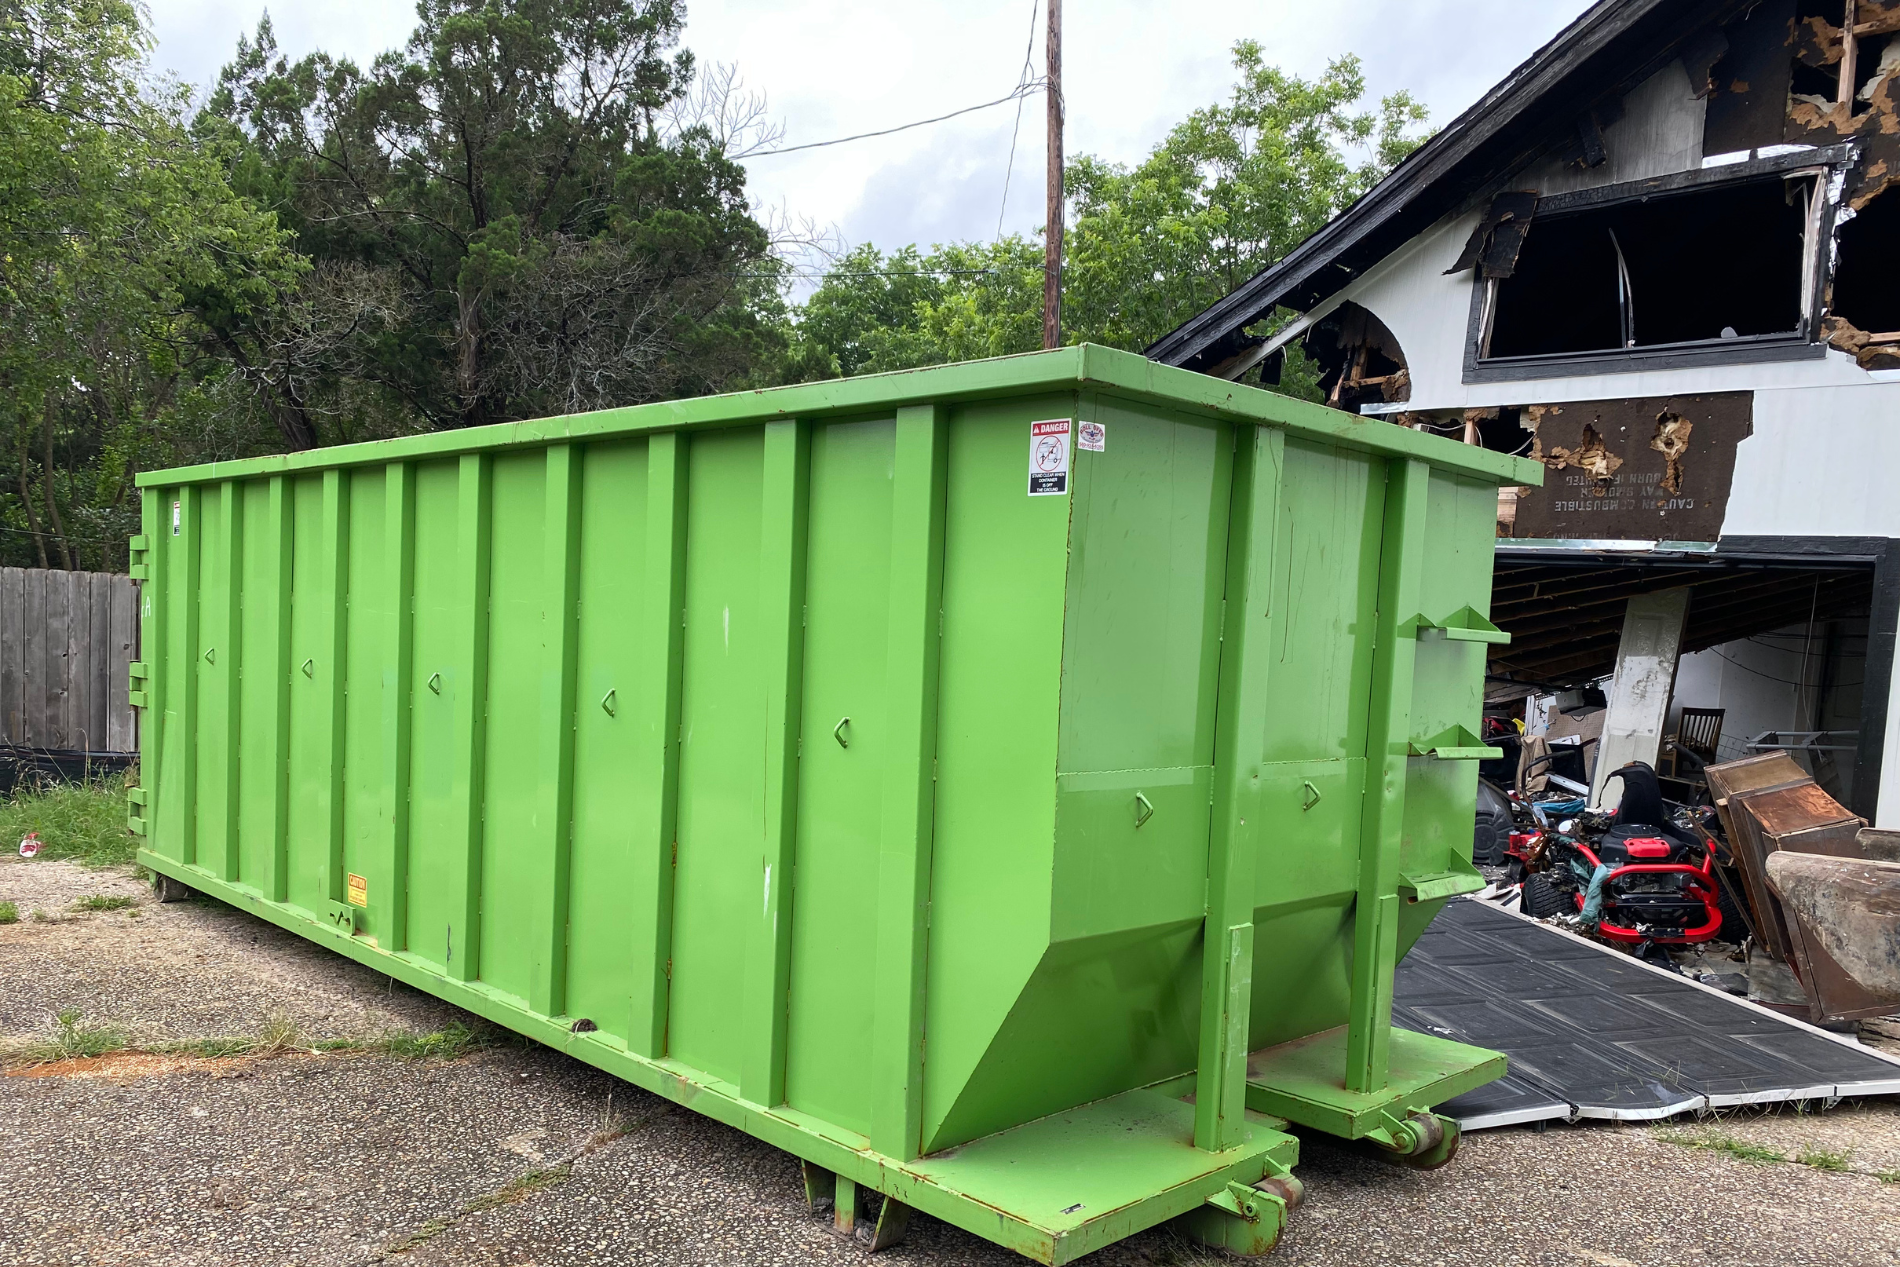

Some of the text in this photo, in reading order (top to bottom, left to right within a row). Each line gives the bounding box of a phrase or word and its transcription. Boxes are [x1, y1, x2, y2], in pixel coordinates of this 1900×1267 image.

[1041, 423, 1068, 433] DANGER
[1613, 474, 1624, 484] IF
[1630, 473, 1662, 484] BURN
[1581, 487, 1634, 498] SMOER
[1555, 498, 1694, 511] CAUTON COMBUSTIBLE
[350, 875, 365, 889] CAUTION
